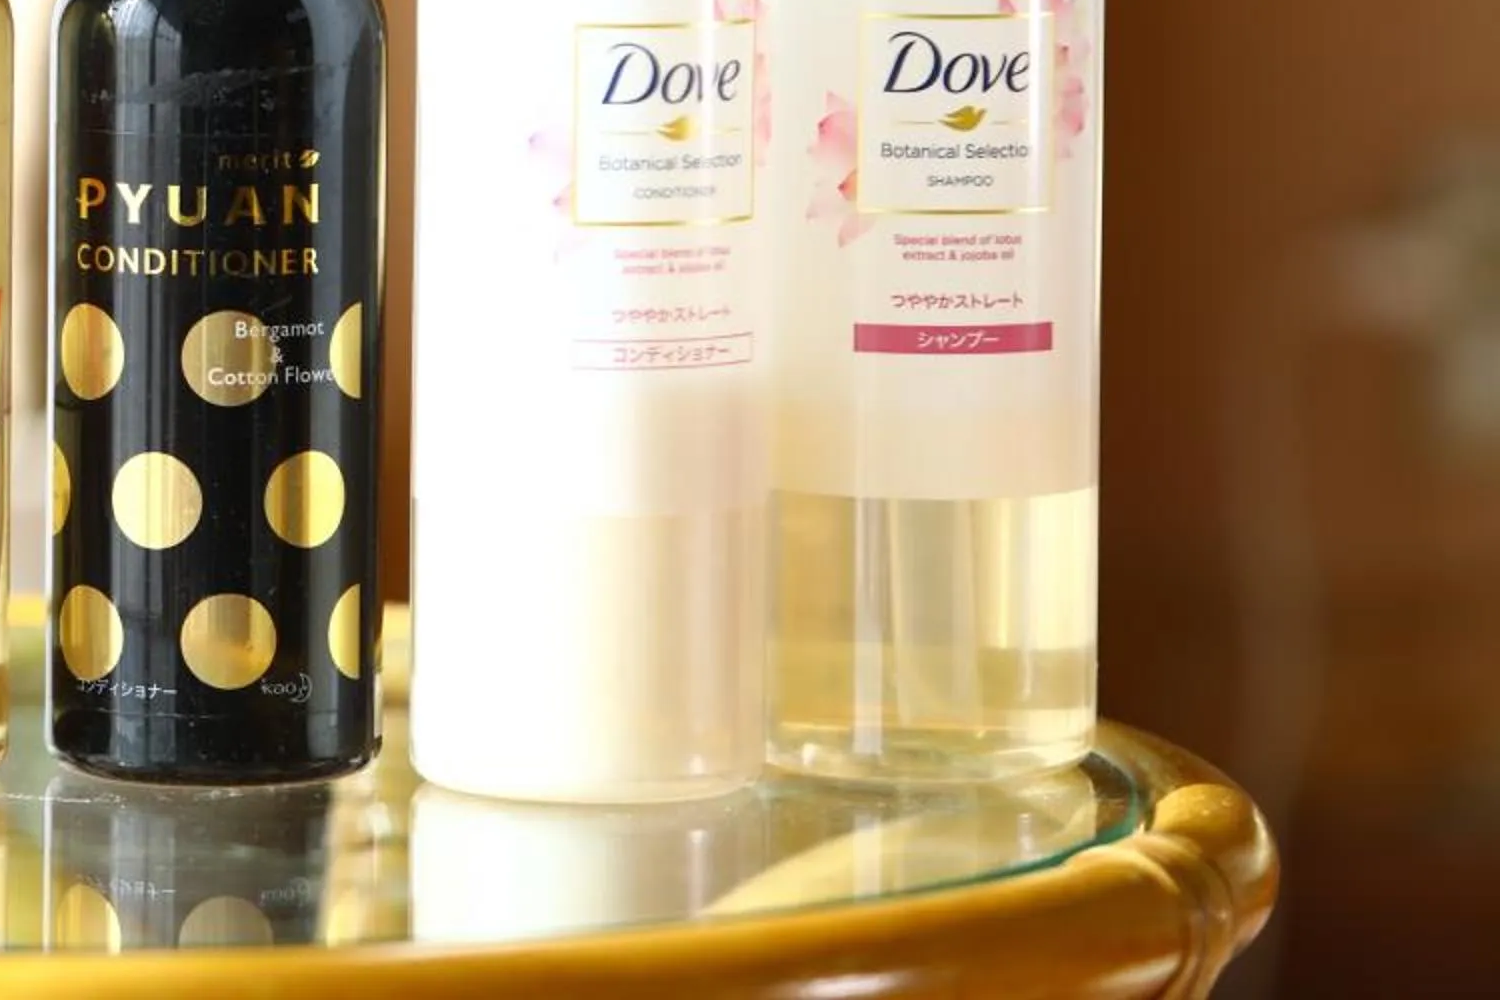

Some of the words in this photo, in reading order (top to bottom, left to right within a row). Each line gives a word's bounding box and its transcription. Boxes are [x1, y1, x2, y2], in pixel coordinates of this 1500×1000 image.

[602, 42, 741, 105] Dove
[883, 31, 1030, 94] Dove
[881, 142, 960, 160] Botanical
[965, 143, 1031, 160] Selectio
[927, 175, 994, 188] SHAMPOO
[76, 177, 320, 226] PYUAN
[77, 243, 318, 276] CONDITIONER
[891, 291, 1024, 310] つややかストレート
[234, 320, 324, 342] Bergamot
[917, 331, 1000, 349] シャンプー
[270, 346, 284, 363] &
[207, 366, 279, 386] Cotton
[285, 364, 336, 384] Flowe
